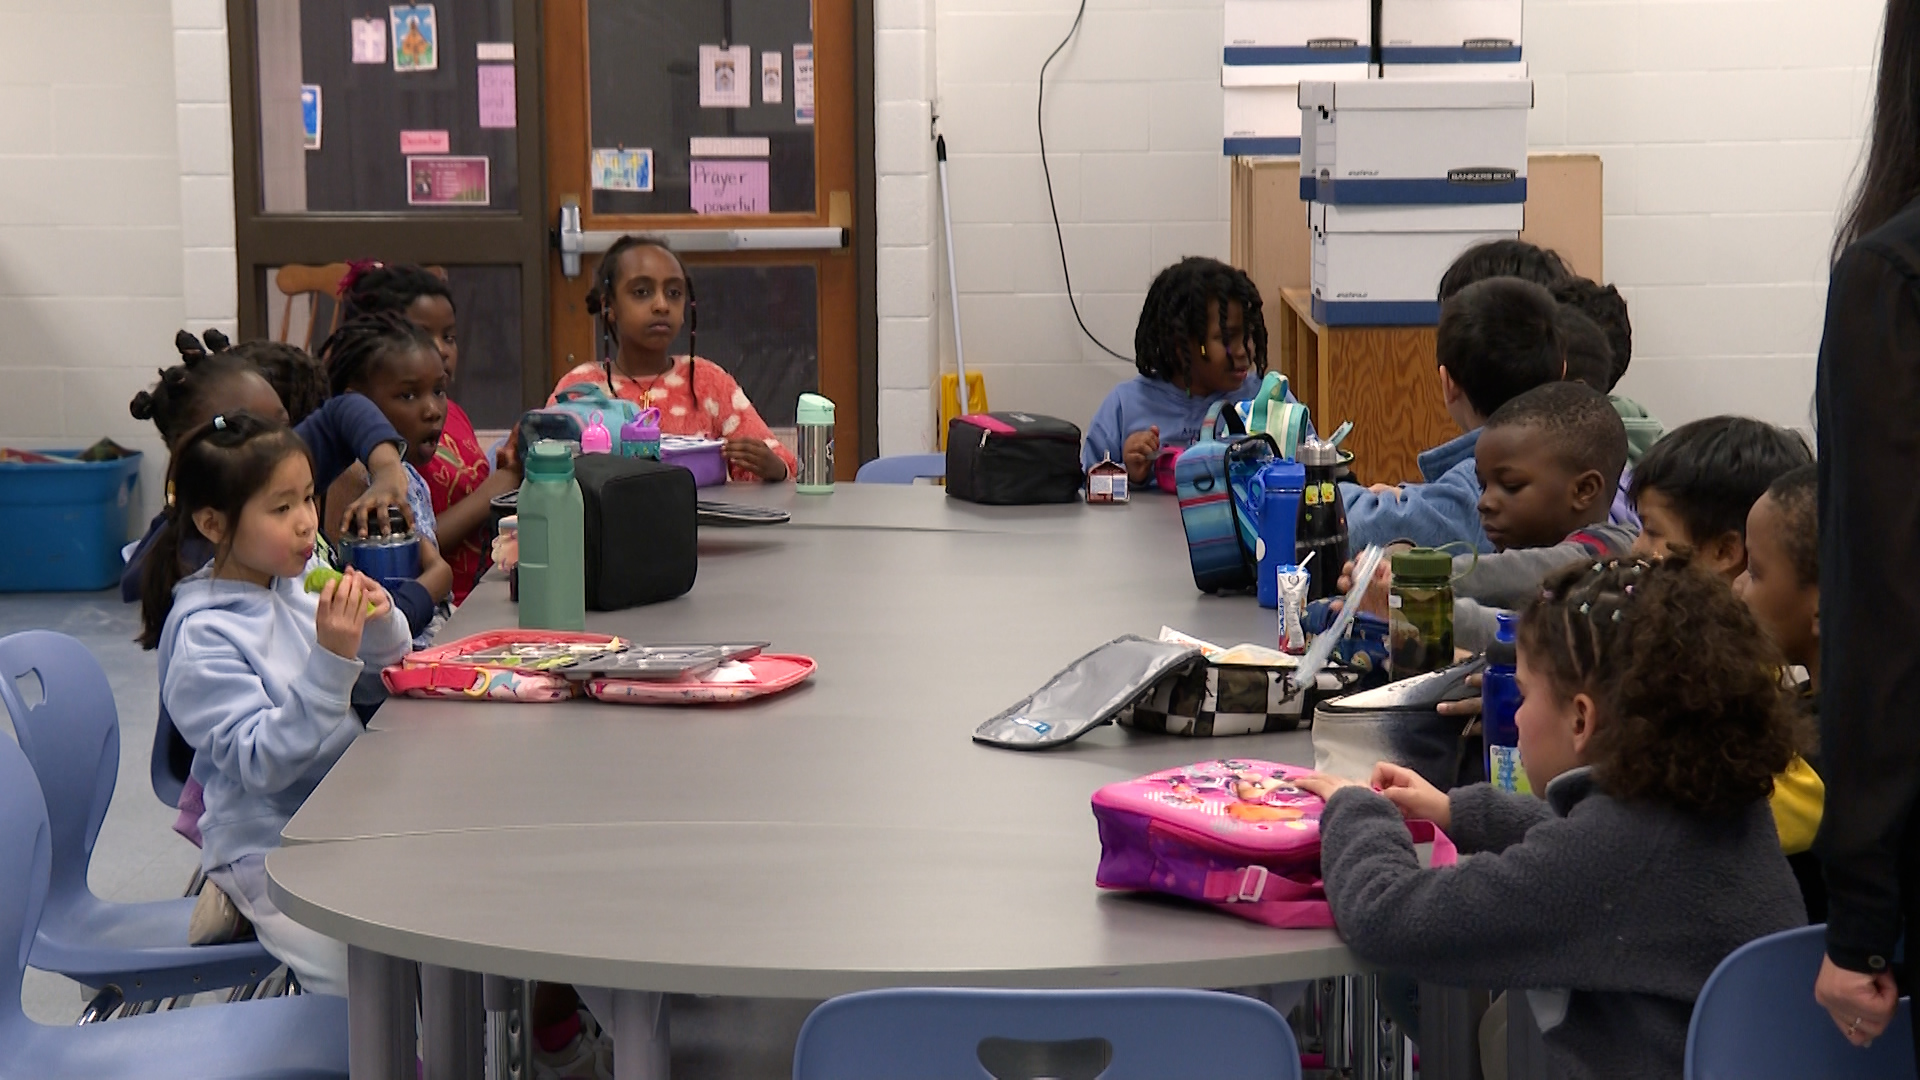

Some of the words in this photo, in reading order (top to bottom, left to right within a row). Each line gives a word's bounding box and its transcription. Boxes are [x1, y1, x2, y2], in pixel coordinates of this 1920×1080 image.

[694, 165, 747, 191] Prayer
[1451, 172, 1492, 181] BANKERS
[703, 197, 755, 213] powerful
